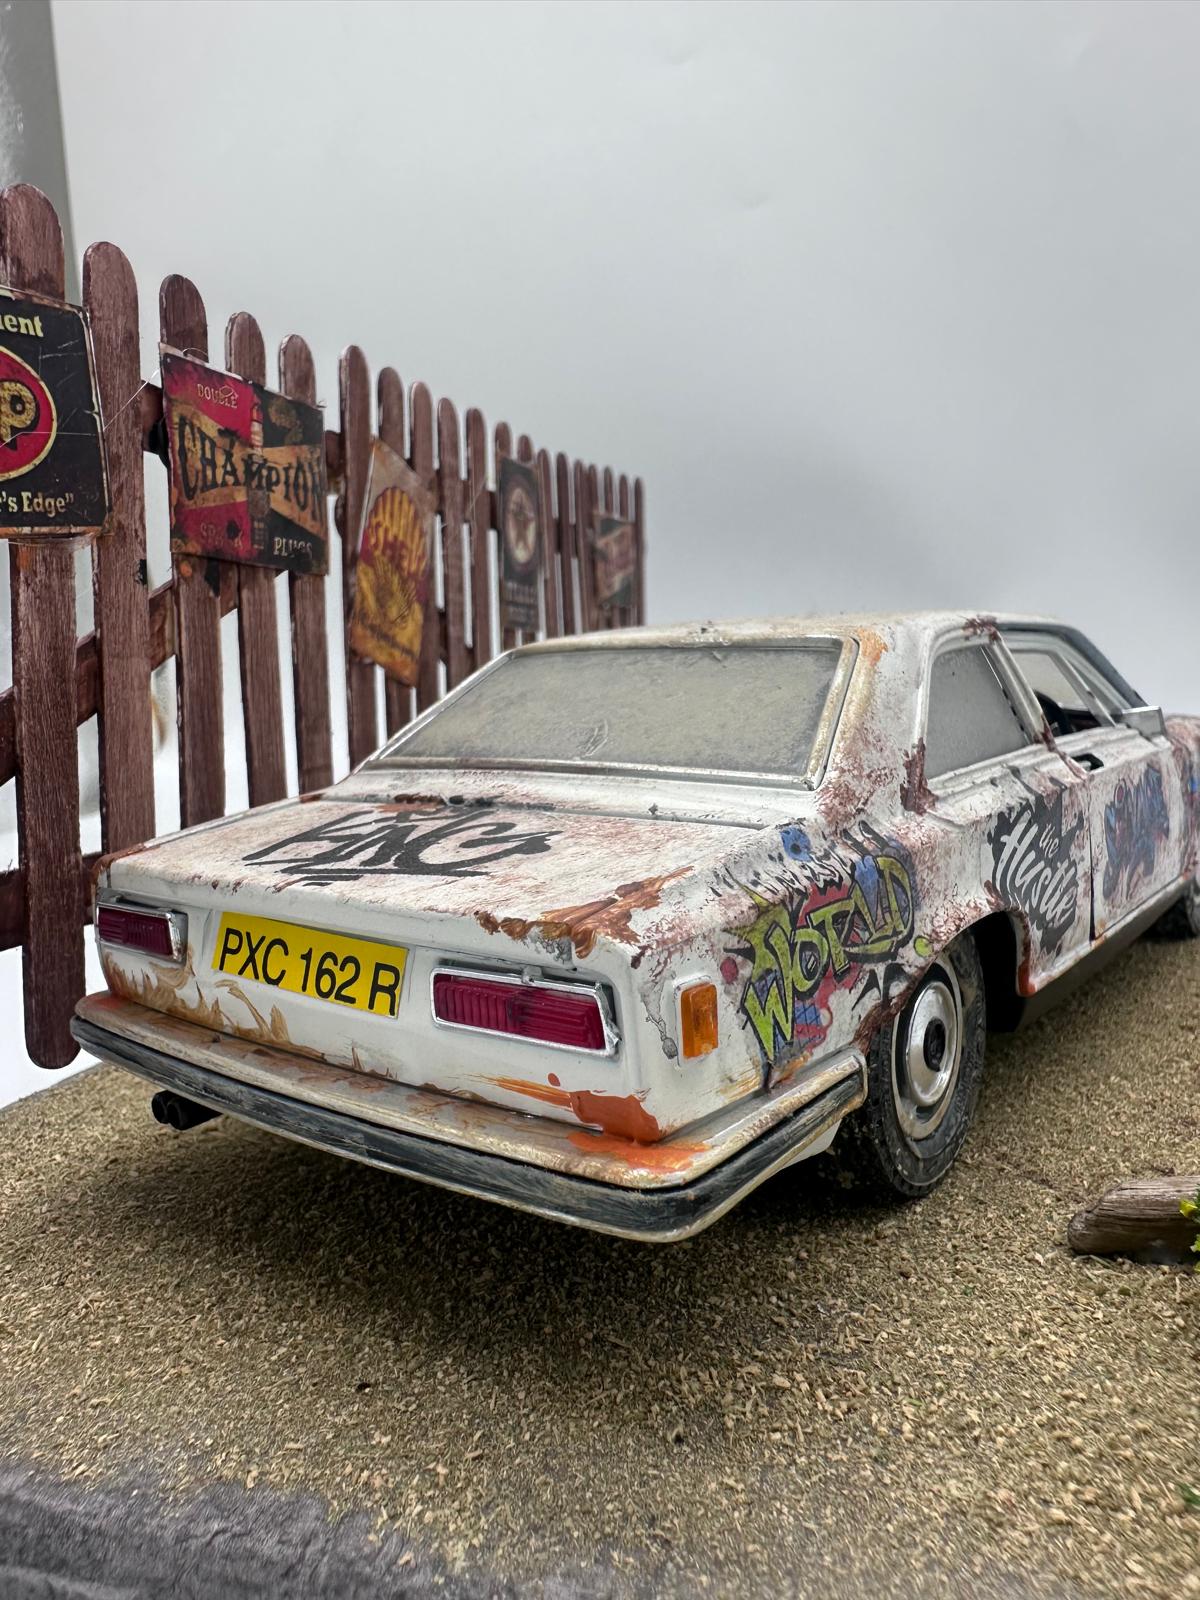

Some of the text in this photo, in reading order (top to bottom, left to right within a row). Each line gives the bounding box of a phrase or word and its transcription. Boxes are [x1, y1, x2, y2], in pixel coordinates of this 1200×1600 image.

[0, 314, 44, 337] ent
[177, 415, 326, 523] CHAMPION
[218, 927, 401, 1017] PXC 162 R
